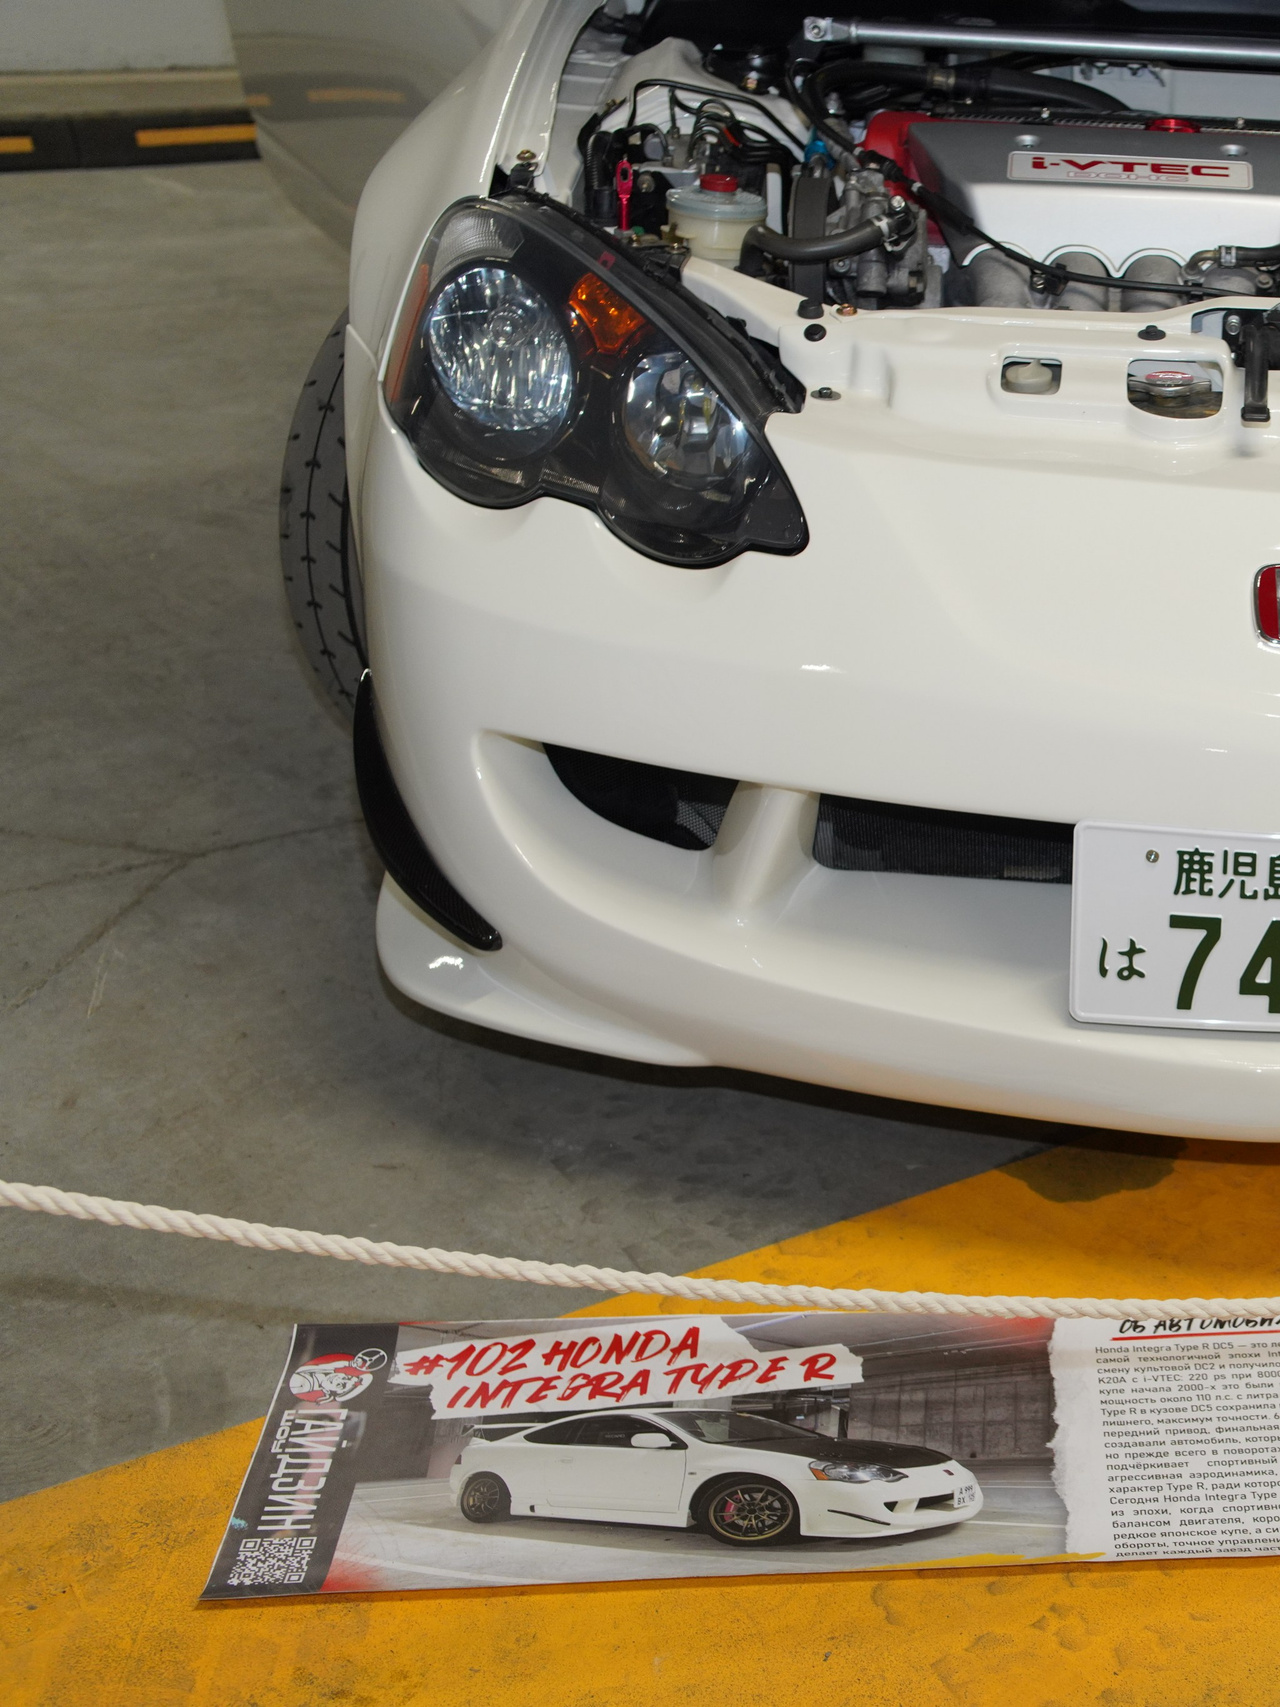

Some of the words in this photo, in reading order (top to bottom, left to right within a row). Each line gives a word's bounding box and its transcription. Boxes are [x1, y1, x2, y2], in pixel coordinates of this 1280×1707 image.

[1031, 157, 1230, 178] i-VTEC
[1099, 937, 1147, 981] は
[404, 1338, 537, 1381] #102
[541, 1326, 701, 1377] HONDA
[1095, 1355, 1131, 1364] самой
[1137, 1352, 1222, 1362] технологичной
[446, 1368, 653, 1410] INTEGRA
[662, 1355, 788, 1396] TYPE
[798, 1352, 838, 1383] R
[1098, 1387, 1126, 1396] купе
[1177, 1383, 1217, 1392] 2000-х
[1244, 1381, 1275, 1389] были
[1156, 1416, 1213, 1426] максимум
[1104, 1440, 1166, 1449] создавали
[1124, 1451, 1170, 1460] прежде
[257, 1408, 348, 1531] ГАЙДЗИН
[1106, 1460, 1190, 1472] подчёркивает
[1206, 1456, 1278, 1468] спортивный
[1107, 1473, 1183, 1483] агрессивная
[1108, 1485, 1164, 1495] характер
[1166, 1482, 1194, 1492] Type
[1210, 1482, 1241, 1491] ради
[1109, 1495, 1159, 1506] Сегодня
[1163, 1493, 1201, 1502] Honda
[1204, 1492, 1247, 1502] Integra
[1251, 1490, 1278, 1500] Type
